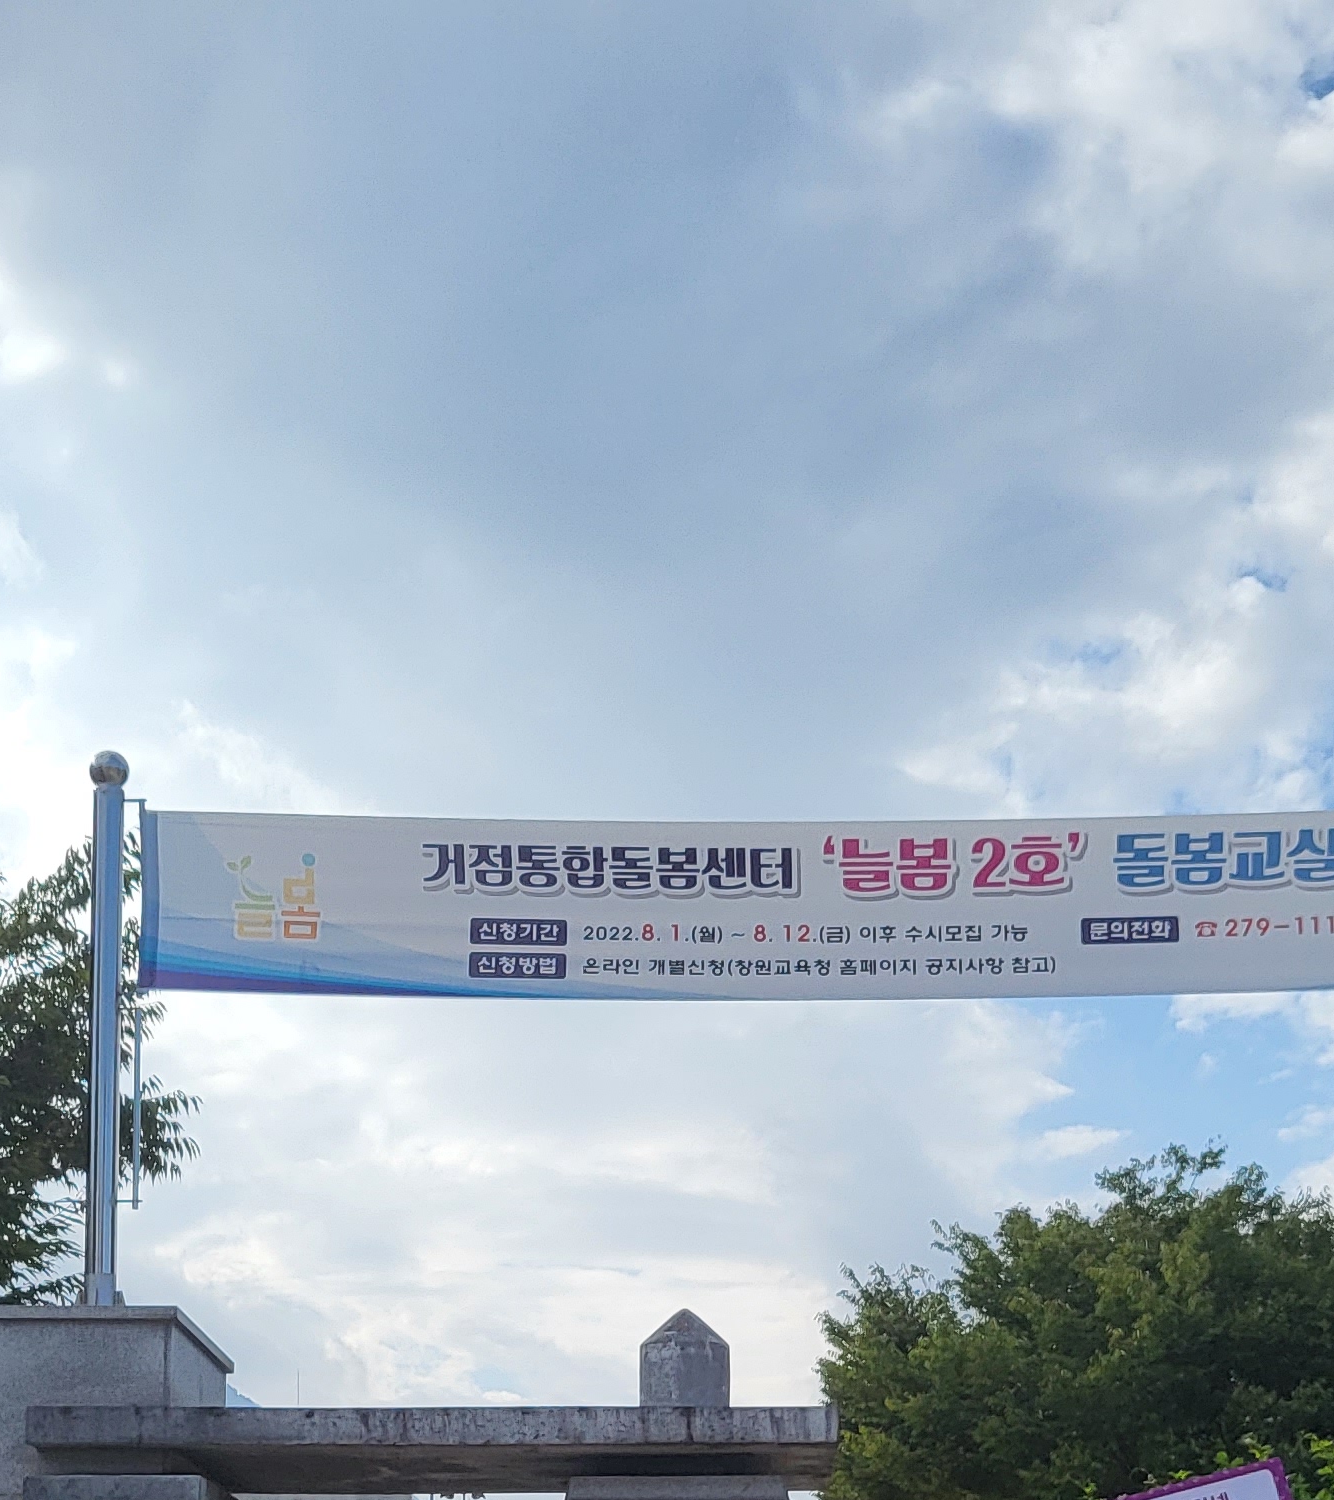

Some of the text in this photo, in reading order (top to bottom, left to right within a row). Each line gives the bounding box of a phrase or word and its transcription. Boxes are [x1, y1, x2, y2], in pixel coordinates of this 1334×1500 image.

[421, 842, 794, 891] 거점통합돌봄센터
[478, 921, 560, 942] 신청기간
[859, 924, 898, 944] 이후
[904, 924, 984, 944] 수시모집
[990, 924, 1029, 944] 가능
[1088, 919, 1173, 942] 문의전화
[477, 955, 558, 975] 신청방법
[581, 957, 641, 976] 온라인
[839, 958, 918, 977] 홈페이지
[924, 957, 1005, 977] 공지사항
[1012, 956, 1057, 977] 참고)
